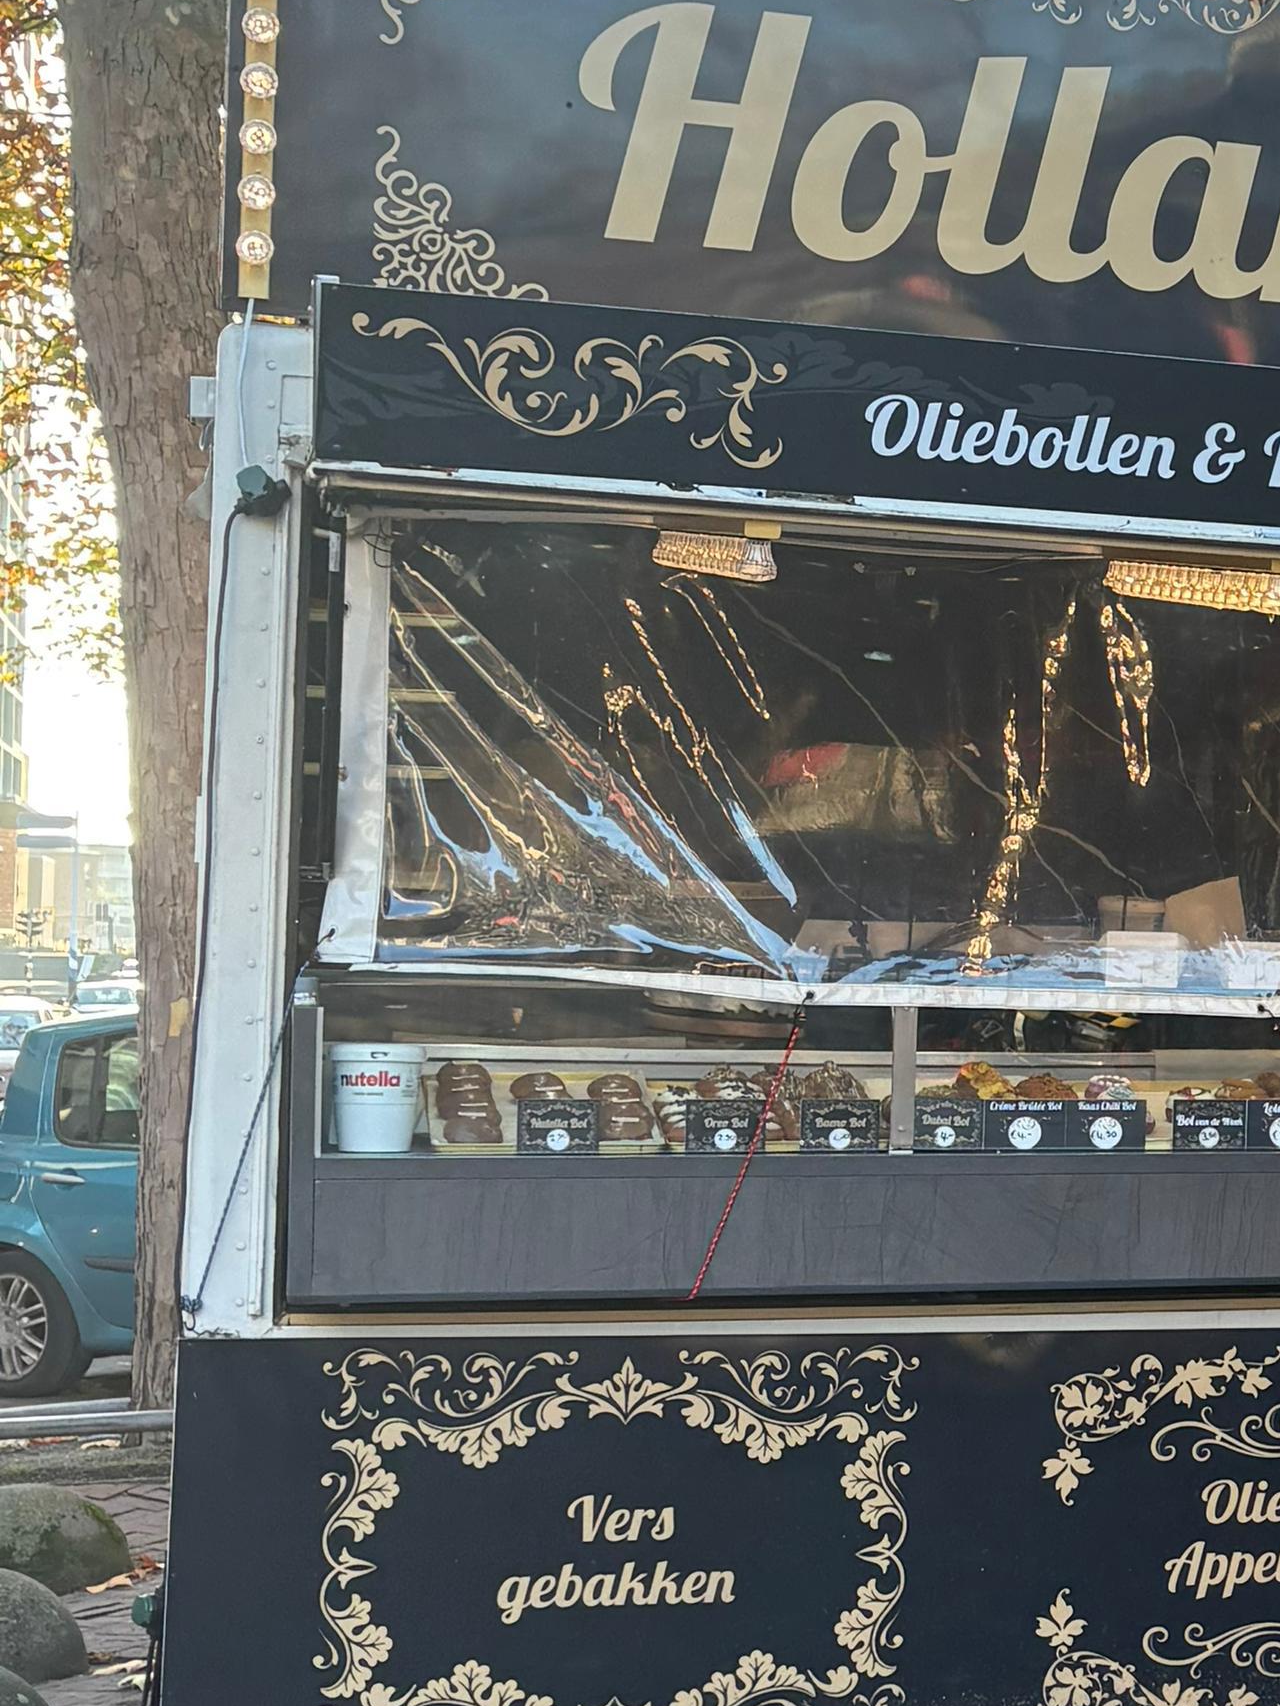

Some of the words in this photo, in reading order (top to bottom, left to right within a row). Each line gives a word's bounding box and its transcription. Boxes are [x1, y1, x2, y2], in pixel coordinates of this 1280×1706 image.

[864, 394, 1176, 480] Oliebollen
[1192, 423, 1246, 483] &
[340, 1071, 401, 1087] nutella
[567, 1494, 675, 1543] Vers
[497, 1560, 736, 1625] gebakken
